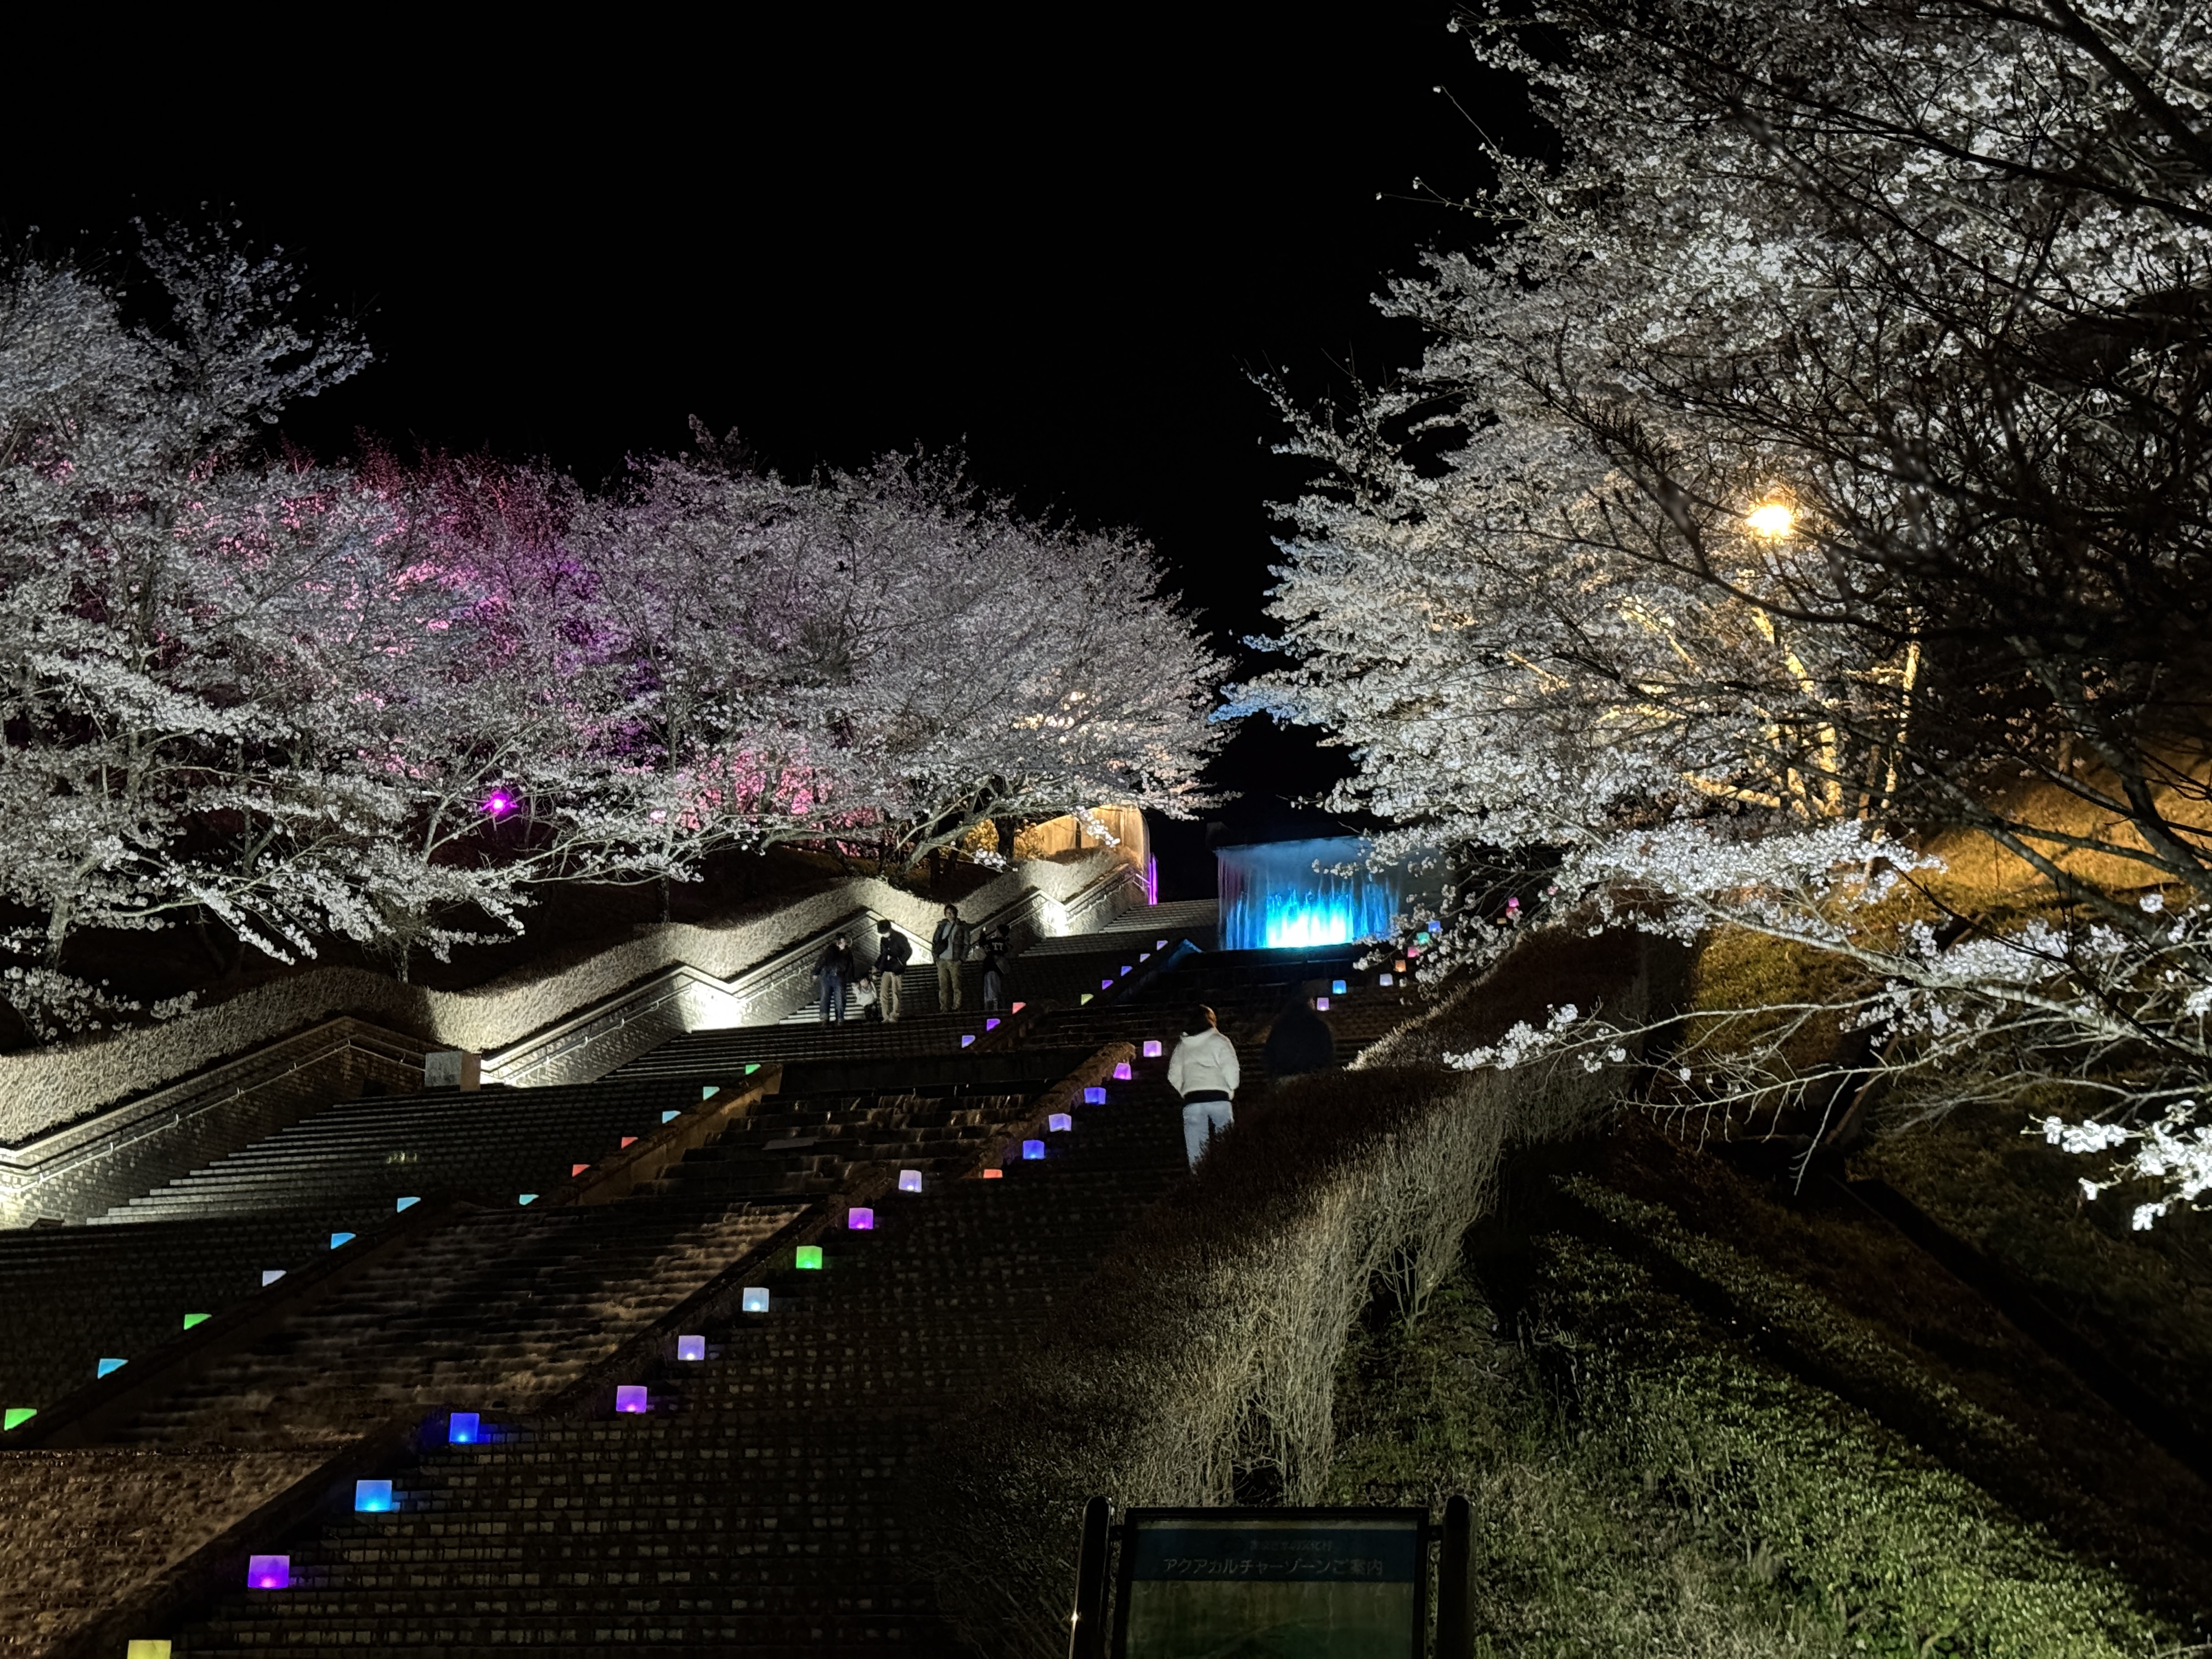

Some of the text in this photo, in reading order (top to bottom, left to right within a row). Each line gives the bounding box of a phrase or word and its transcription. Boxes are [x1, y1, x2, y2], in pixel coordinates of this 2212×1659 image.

[1164, 1558, 1383, 1576] アクアカルチャーゾーンご案内
